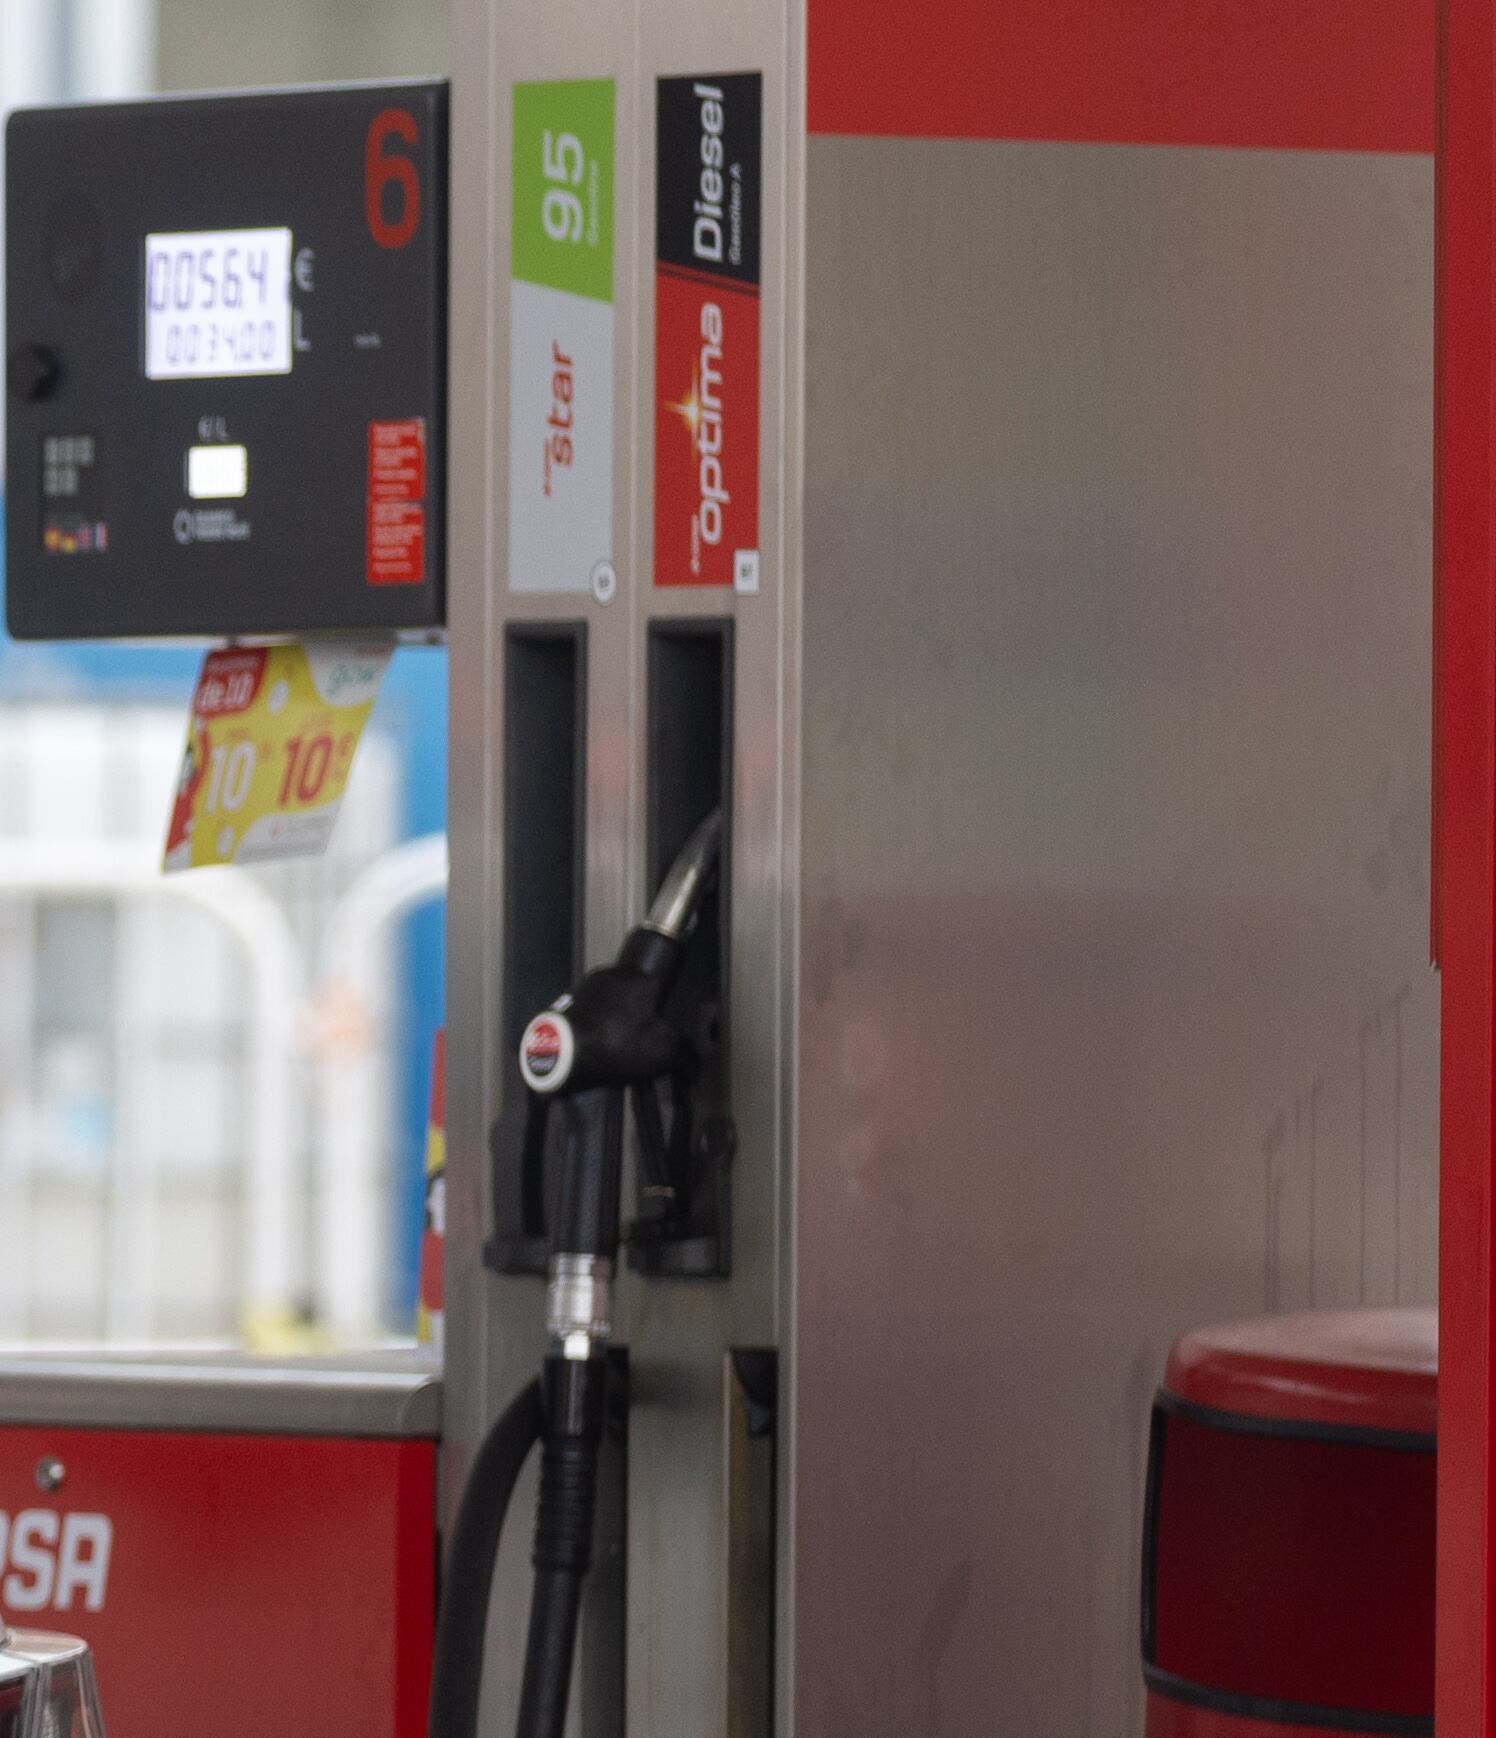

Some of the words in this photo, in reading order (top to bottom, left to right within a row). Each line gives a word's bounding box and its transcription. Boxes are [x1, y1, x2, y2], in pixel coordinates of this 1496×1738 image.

[365, 108, 421, 249] 6
[541, 129, 584, 247] 95
[693, 82, 724, 262] Diesel
[294, 247, 315, 292] €
[294, 306, 312, 351] L
[549, 338, 574, 468] star
[699, 302, 731, 545] optima
[204, 740, 257, 815] 10
